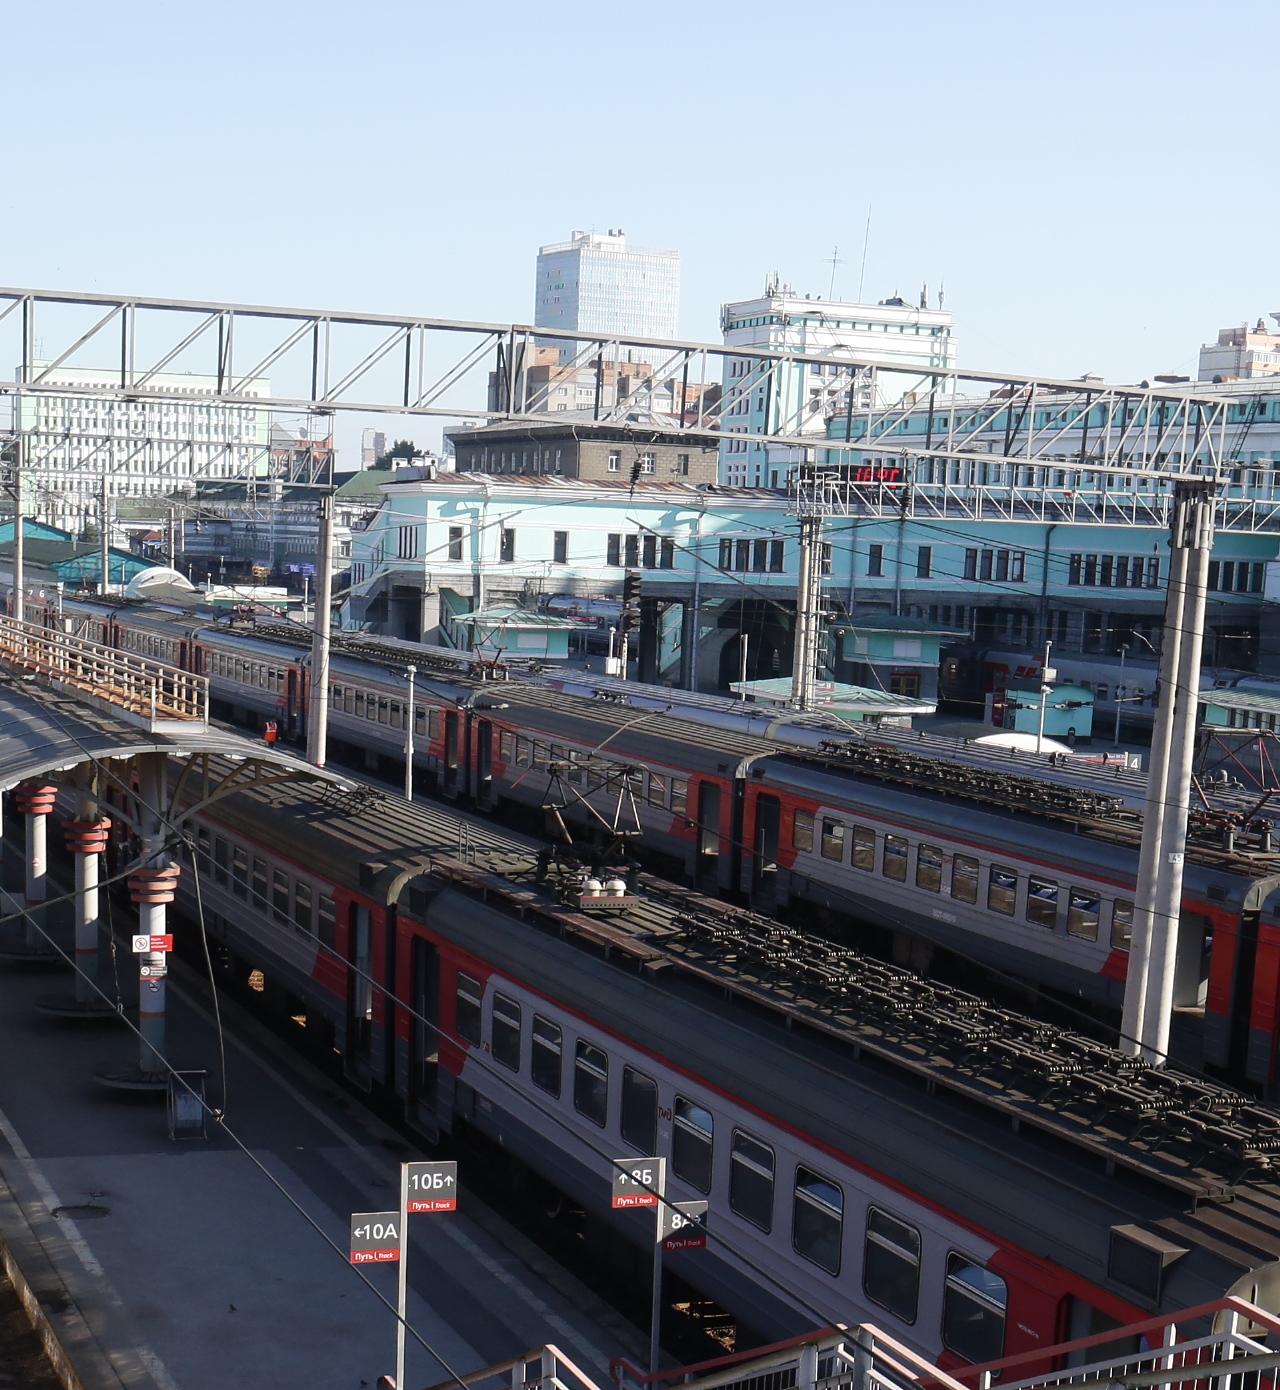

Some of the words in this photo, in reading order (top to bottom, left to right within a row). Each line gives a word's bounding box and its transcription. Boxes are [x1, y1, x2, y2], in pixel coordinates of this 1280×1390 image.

[39, 589, 45, 598] 6
[1130, 757, 1139, 769] 4
[411, 1173, 444, 1190] 10Б
[631, 1169, 653, 1185] 8Б
[412, 1202, 430, 1210] Путь
[617, 1197, 634, 1206] Путь
[363, 1223, 398, 1240] 10А
[355, 1252, 374, 1262] Путь
